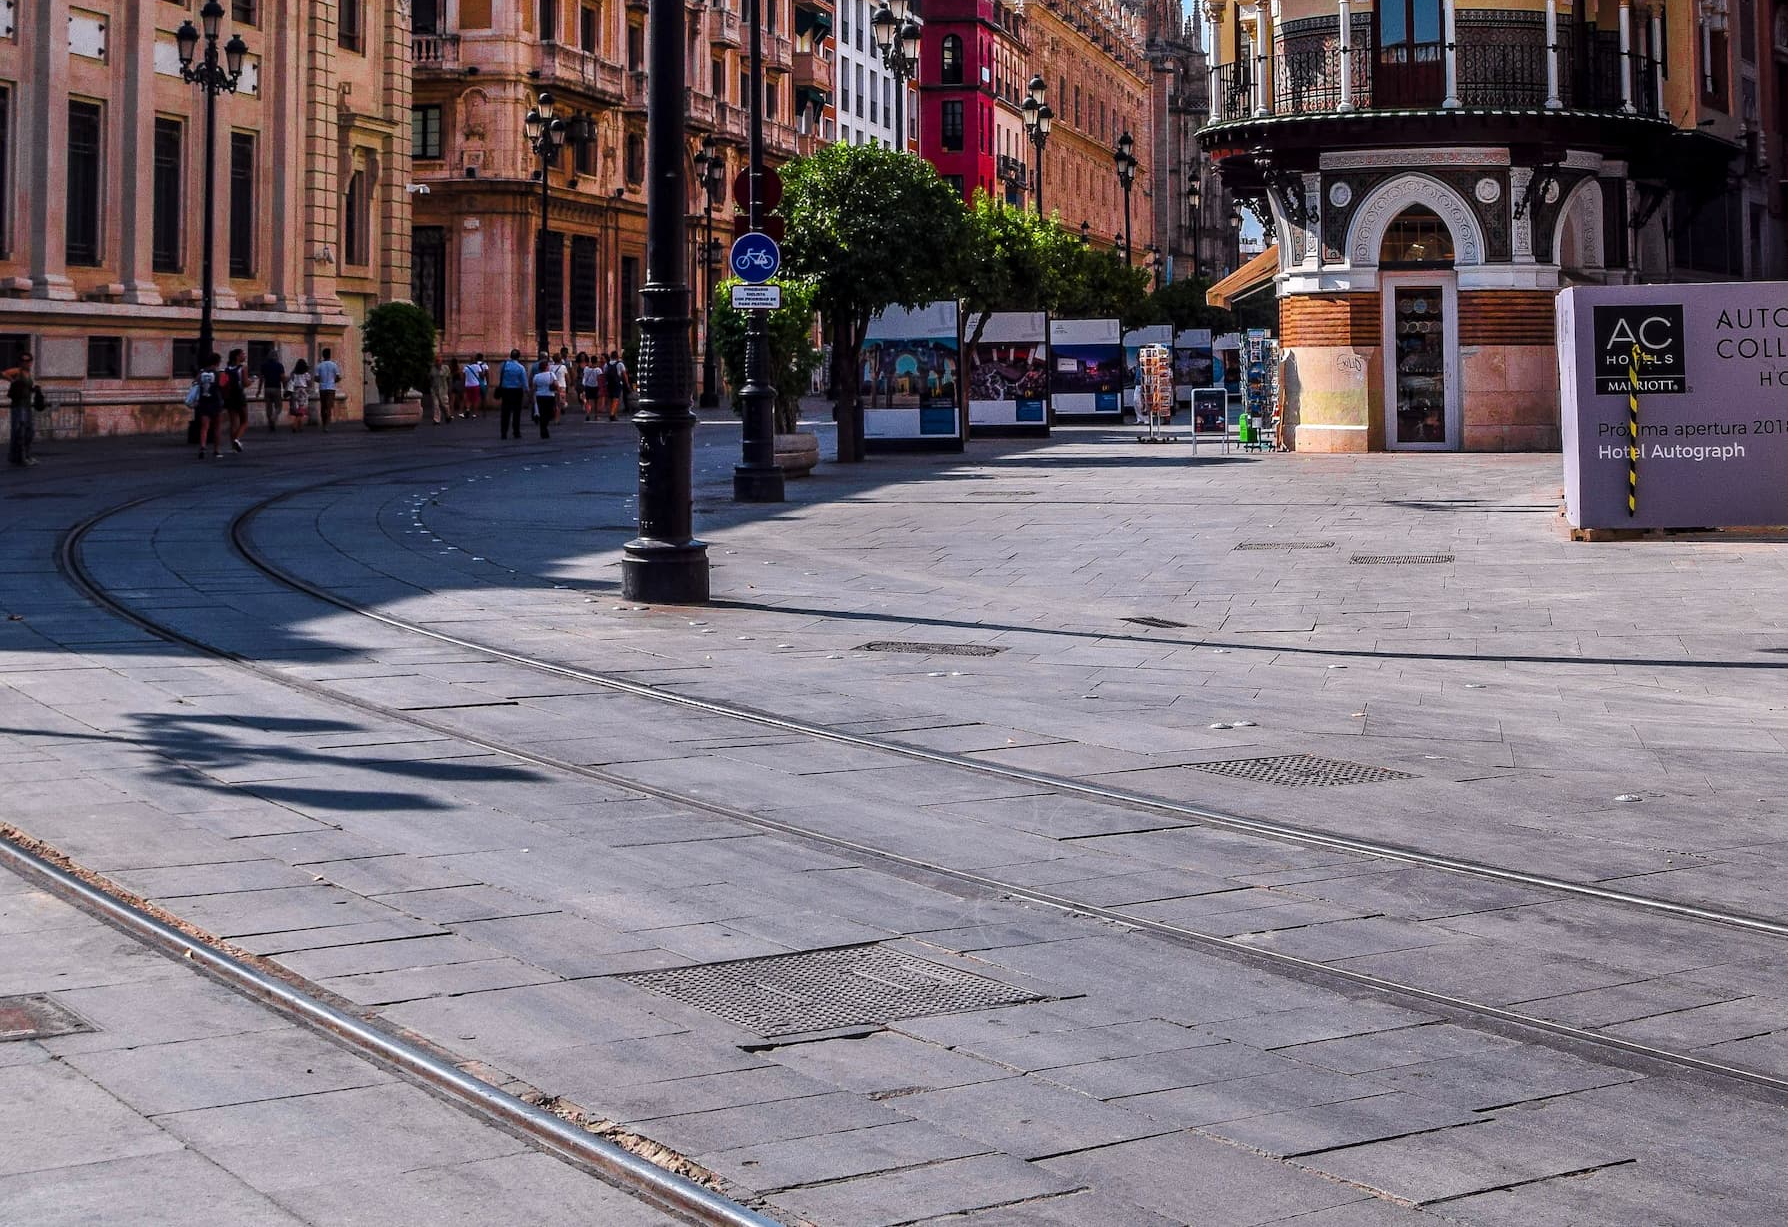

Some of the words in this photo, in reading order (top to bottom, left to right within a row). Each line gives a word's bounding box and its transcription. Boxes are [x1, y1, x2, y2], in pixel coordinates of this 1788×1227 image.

[1716, 307, 1788, 329] AUTO
[1606, 316, 1673, 350] AC
[1716, 337, 1787, 359] COLL
[1606, 354, 1674, 365] HOLS
[1598, 421, 1668, 437] Próma
[1674, 422, 1747, 439] apertura
[1753, 419, 1788, 434] 201
[1598, 443, 1645, 460] Hotel
[1651, 441, 1745, 461] Autograph
